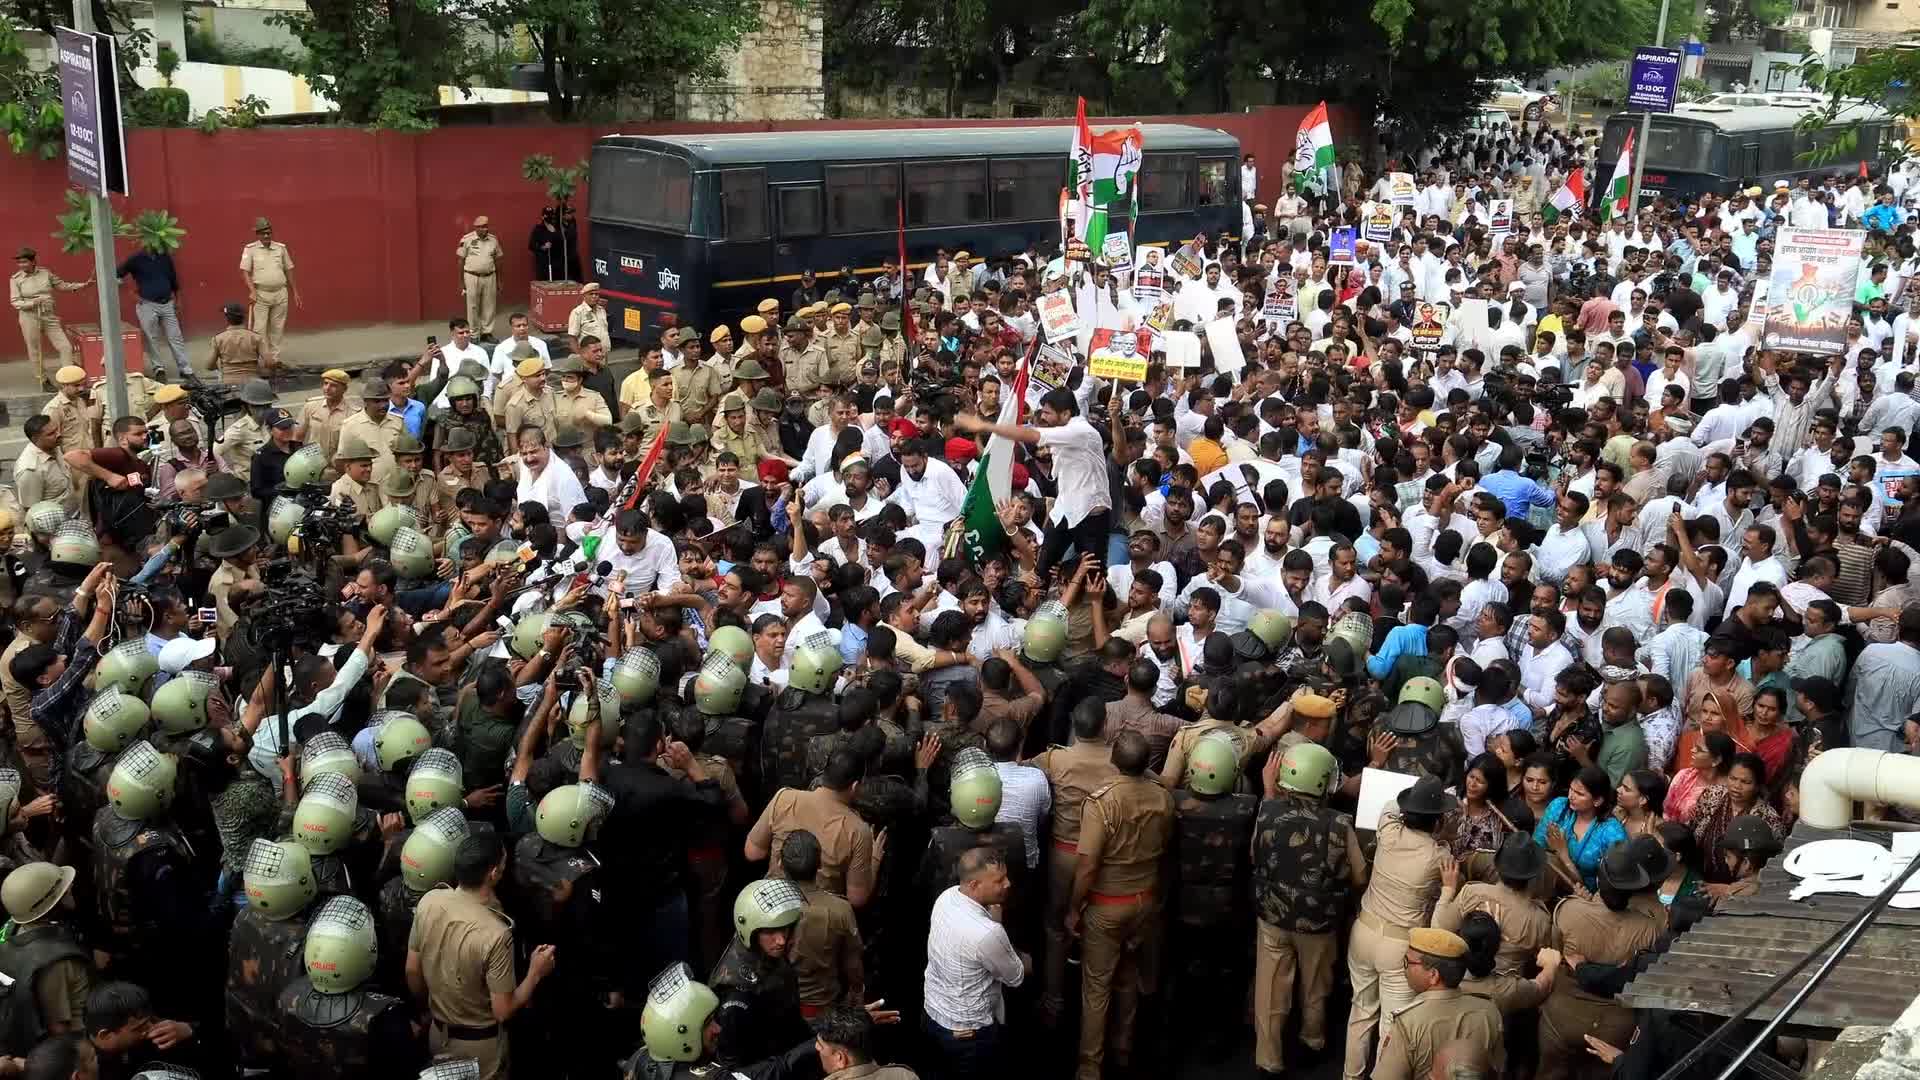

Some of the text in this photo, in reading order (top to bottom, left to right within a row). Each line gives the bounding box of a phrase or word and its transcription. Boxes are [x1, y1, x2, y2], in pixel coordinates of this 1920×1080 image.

[60, 49, 92, 72] ASPIRATION
[1636, 53, 1678, 64] ASPIRATION
[1637, 84, 1667, 93] 12-13 OCT
[83, 128, 94, 145] OCT
[1640, 189, 1660, 197] ATA
[620, 257, 643, 269] TATA
[657, 267, 681, 291] पुलिस
[303, 823, 328, 833] POLICE
[310, 960, 337, 971] POLICE
